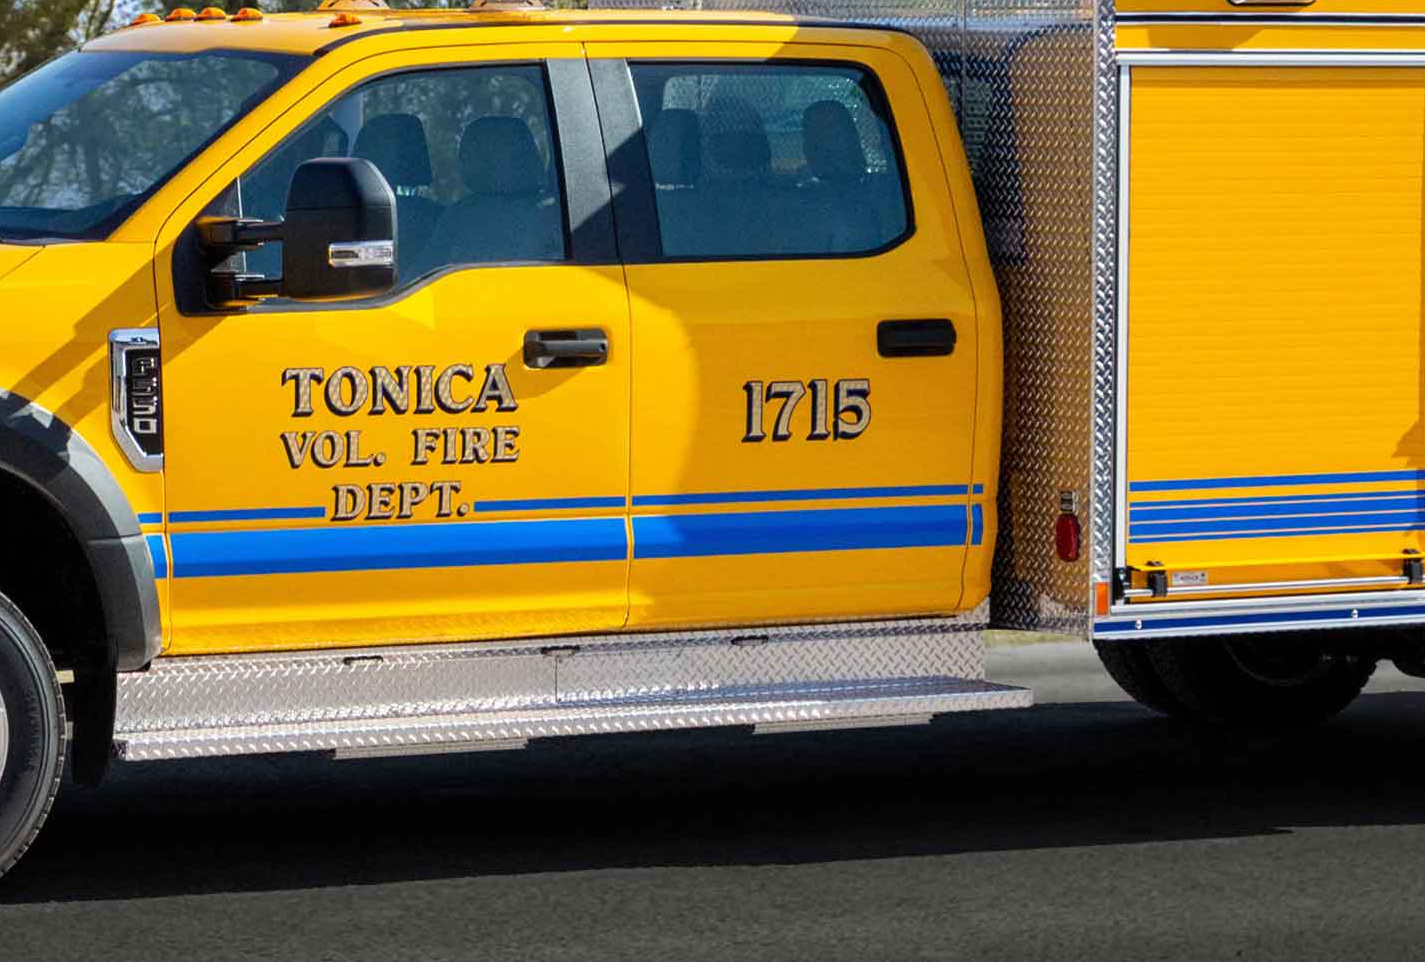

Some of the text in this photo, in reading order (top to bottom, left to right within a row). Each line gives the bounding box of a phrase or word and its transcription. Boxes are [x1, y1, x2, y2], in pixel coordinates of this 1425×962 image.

[281, 363, 519, 418] TONICA
[741, 378, 872, 443] 1715
[280, 425, 521, 470] VOL. FIRE
[330, 480, 470, 522] DEPT.
